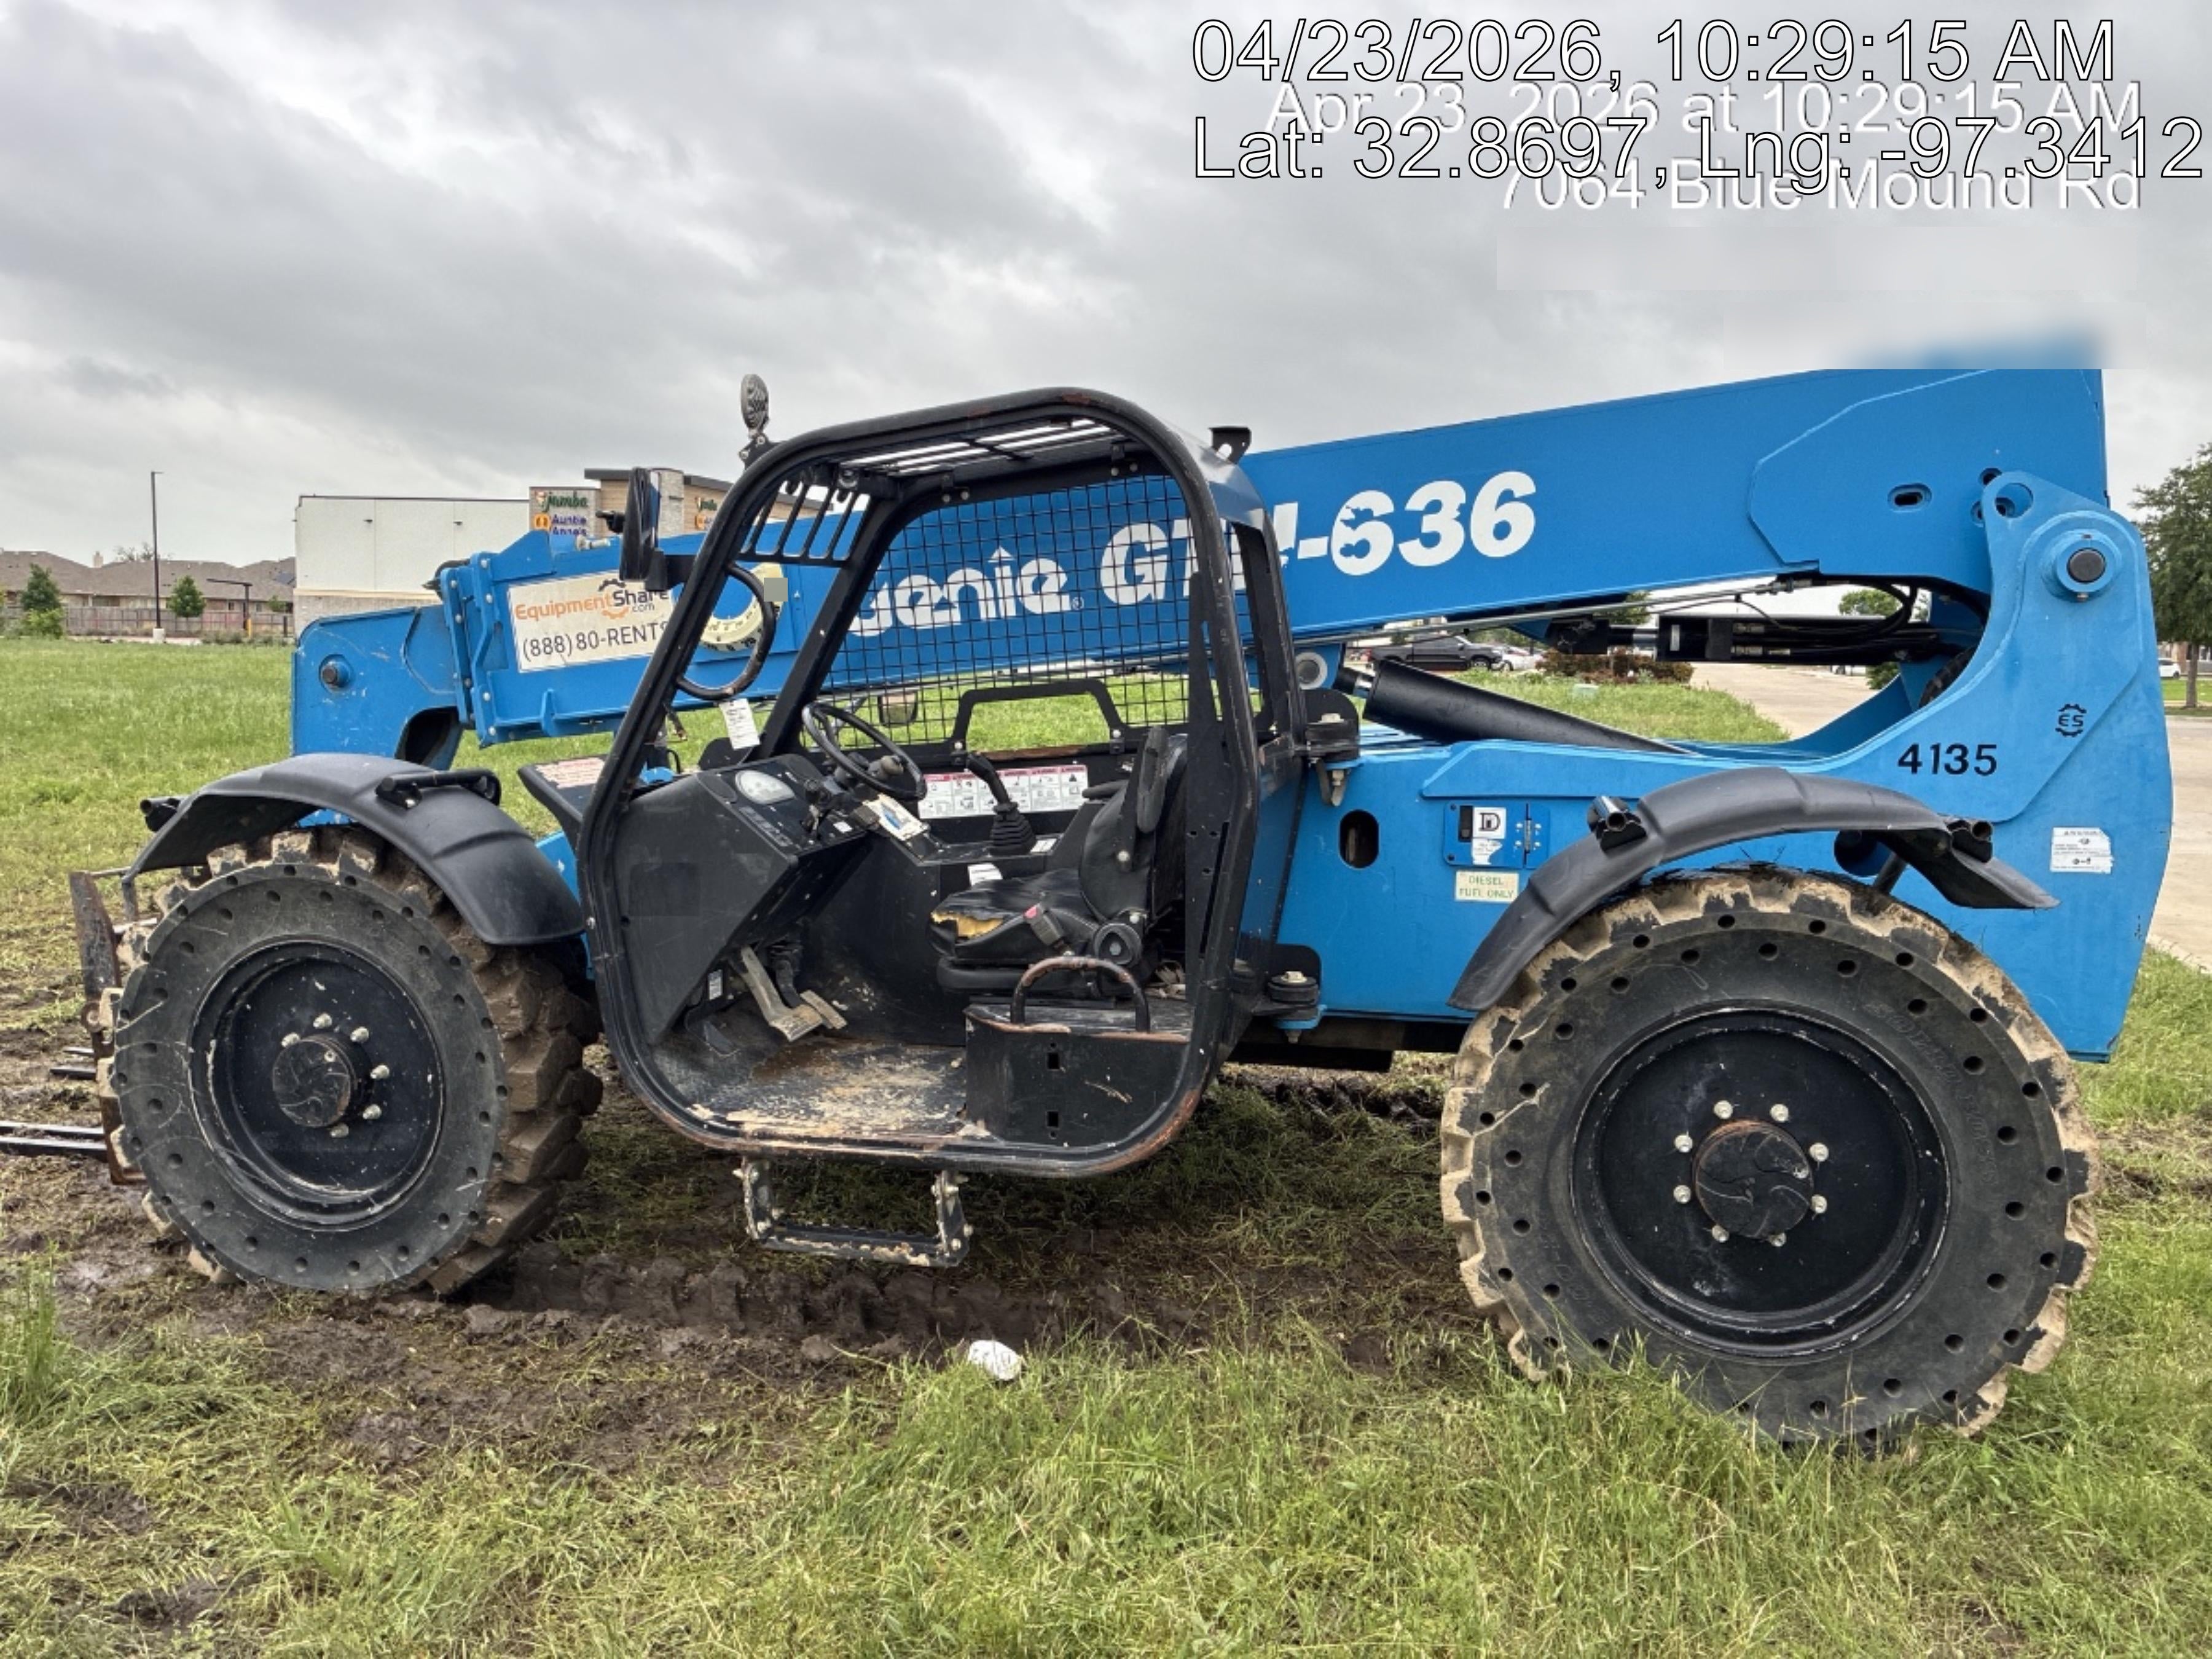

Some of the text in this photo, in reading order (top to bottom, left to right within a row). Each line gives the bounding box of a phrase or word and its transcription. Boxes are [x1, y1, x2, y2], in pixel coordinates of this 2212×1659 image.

[1100, 471, 1536, 605] G-636
[515, 589, 669, 621] EquipmentShare
[523, 633, 571, 662] (888)
[2058, 713, 2084, 728] ES
[1897, 742, 1998, 776] 4135
[1459, 888, 1515, 898] FUEL ONLY
[1469, 876, 1504, 885] DIESEL
